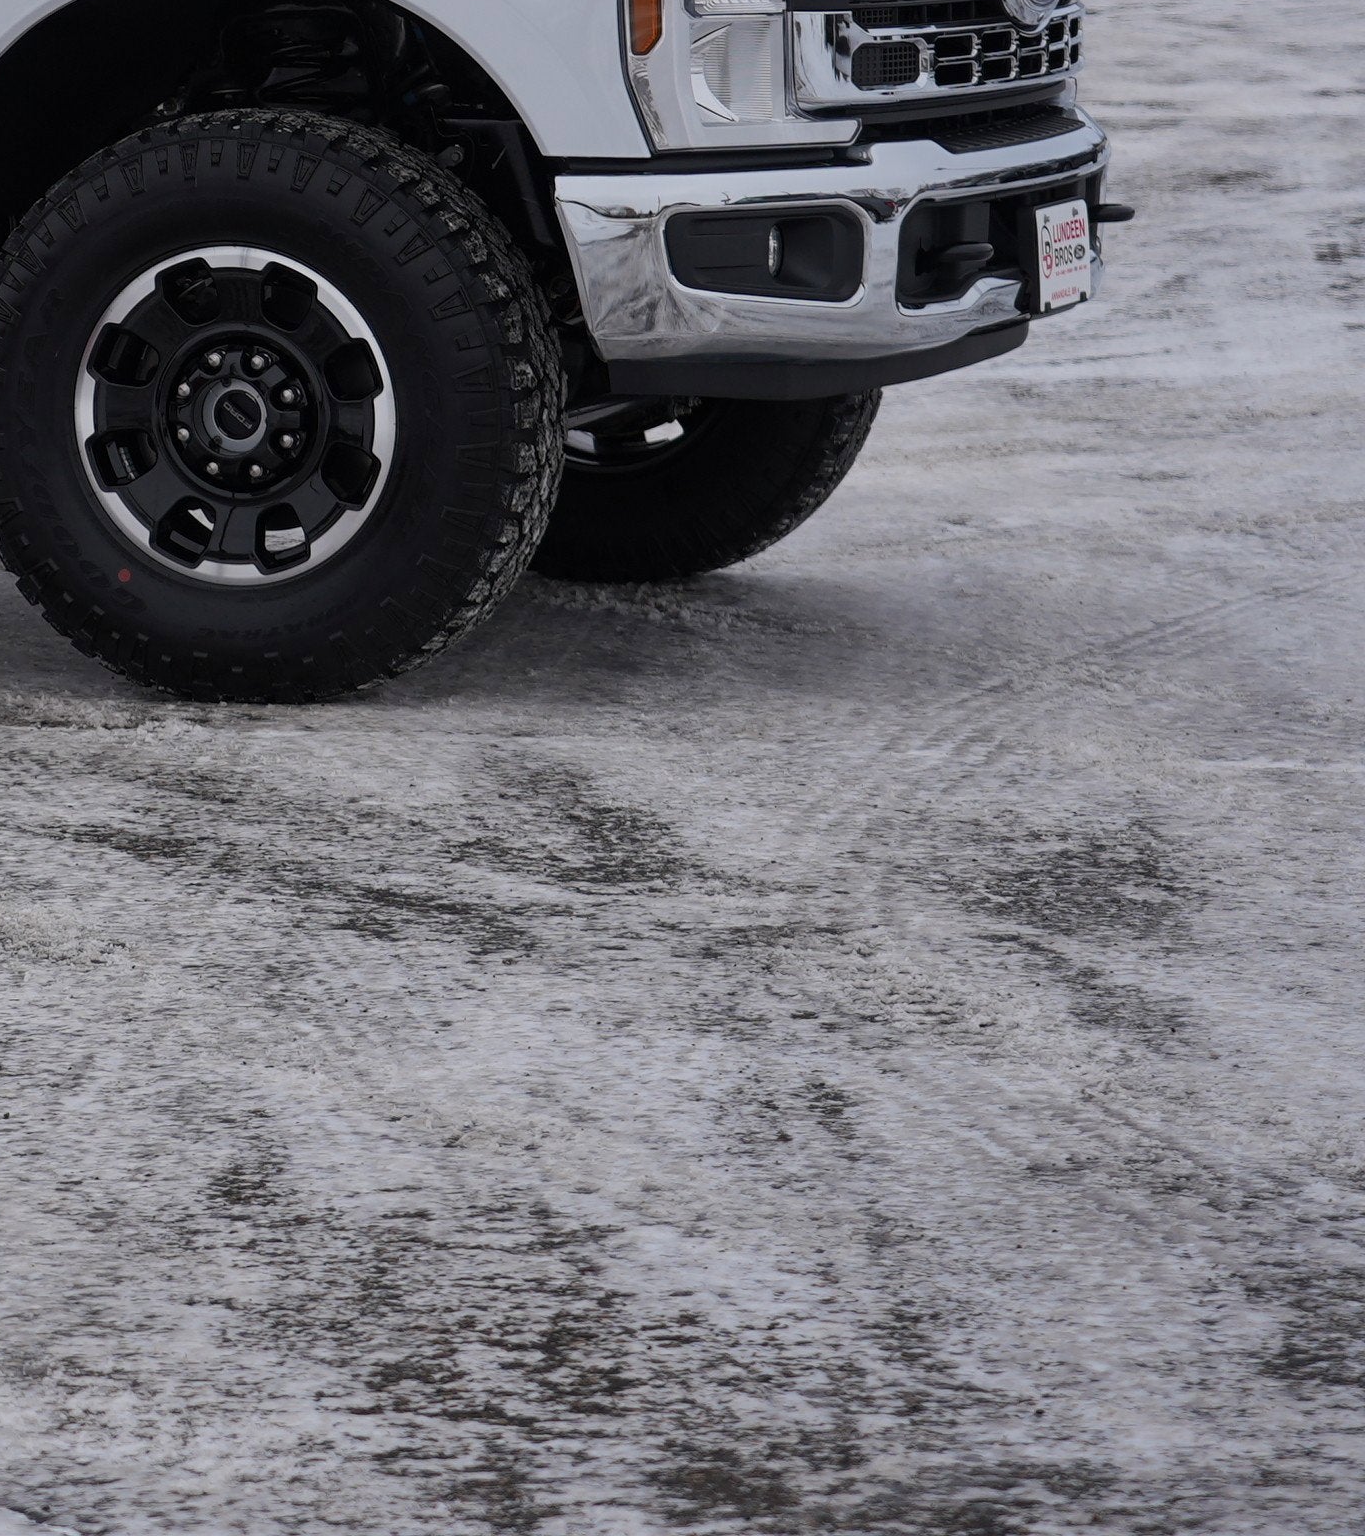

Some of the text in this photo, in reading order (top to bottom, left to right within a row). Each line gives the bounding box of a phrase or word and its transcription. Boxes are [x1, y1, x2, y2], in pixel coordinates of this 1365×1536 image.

[1052, 218, 1086, 243] LUNDEEN
[1054, 244, 1073, 268] BROS
[222, 401, 253, 430] FORD
